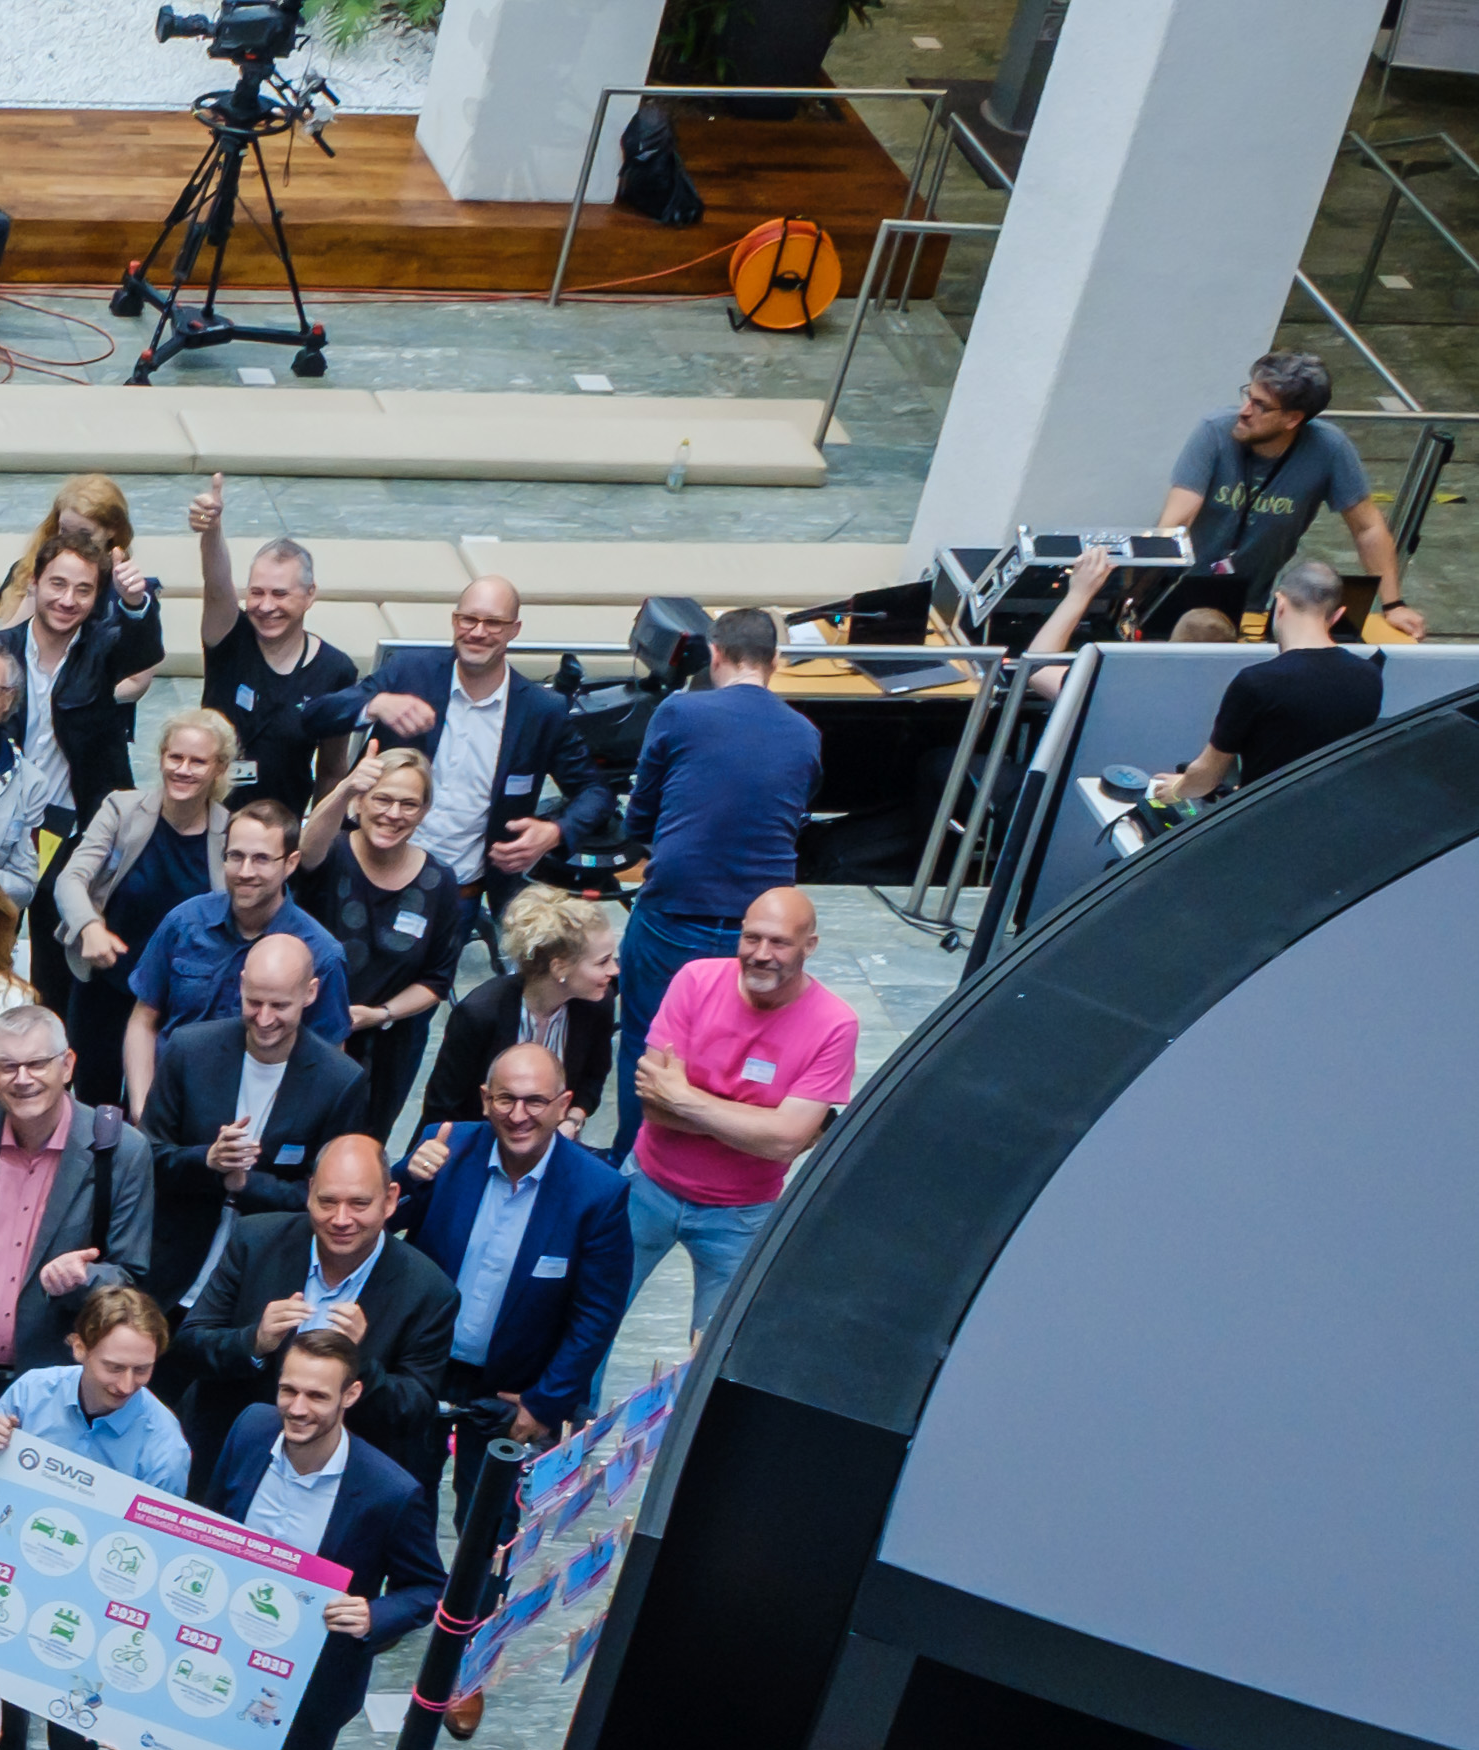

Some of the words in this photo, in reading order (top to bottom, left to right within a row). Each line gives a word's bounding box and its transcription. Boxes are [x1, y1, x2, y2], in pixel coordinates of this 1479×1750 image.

[43, 1456, 96, 1486] SWB
[246, 1538, 271, 1554] UND
[108, 1604, 146, 1627] 2023
